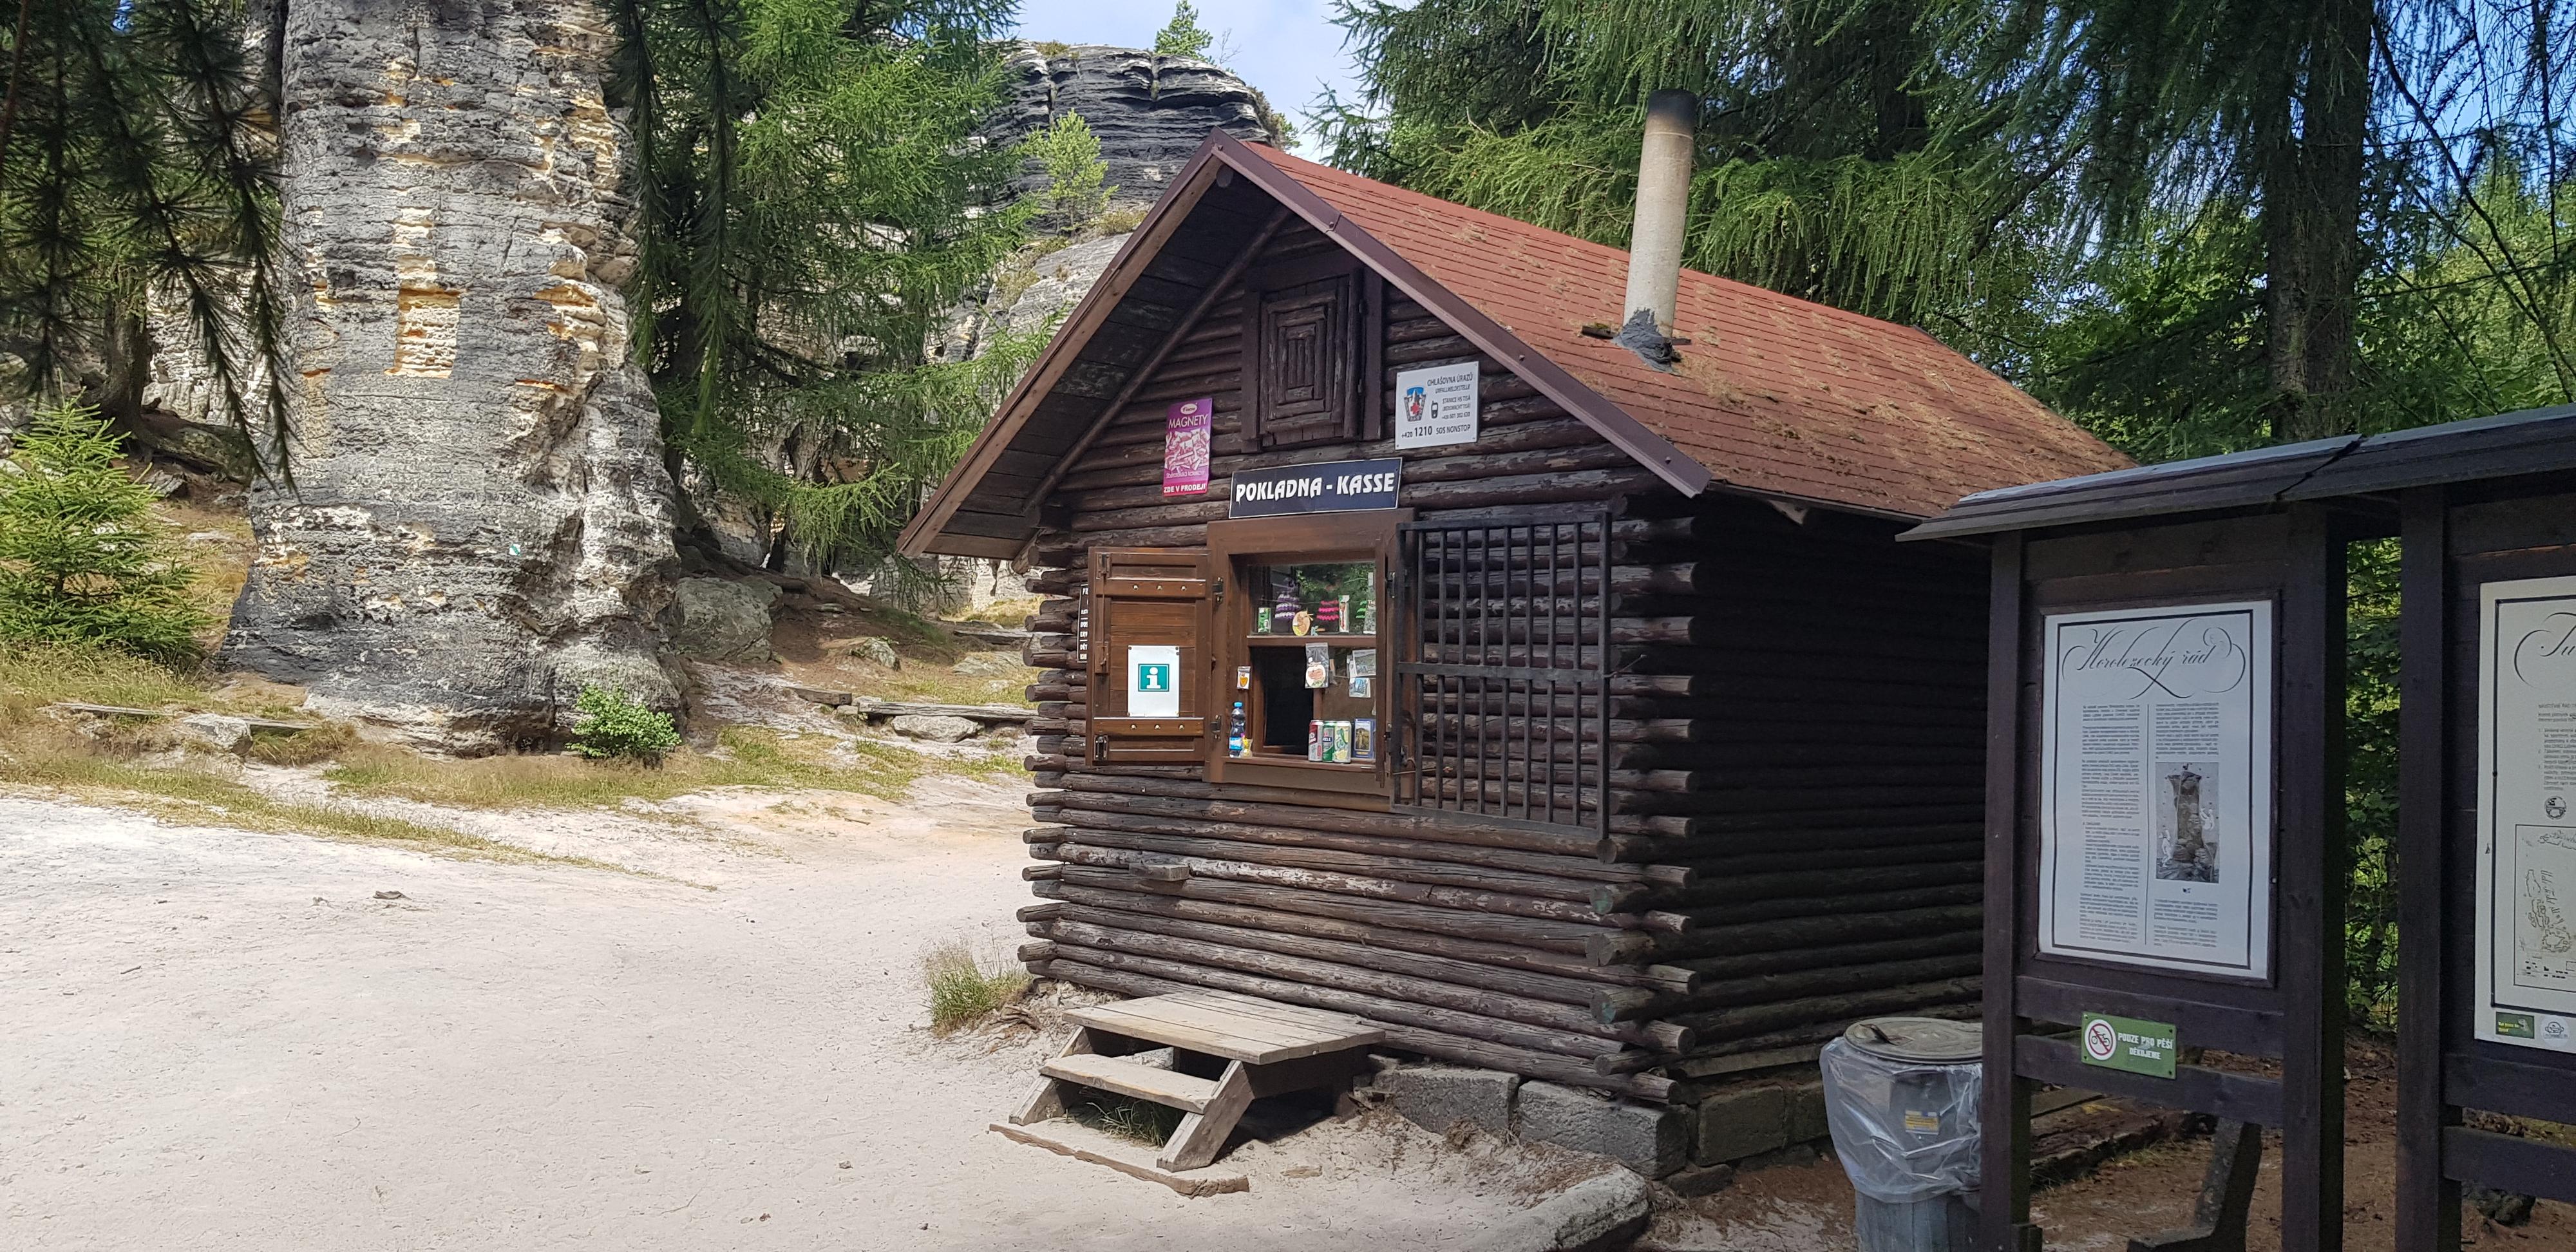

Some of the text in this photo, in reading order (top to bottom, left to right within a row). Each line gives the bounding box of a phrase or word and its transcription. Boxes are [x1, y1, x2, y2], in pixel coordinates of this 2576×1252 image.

[1168, 414, 1208, 429] MAGNETY
[1414, 426, 1432, 437] 1210
[1436, 426, 1446, 435] SOS
[1446, 424, 1471, 432] NONSTOP
[1236, 477, 1323, 502] POKLADNA
[1336, 473, 1395, 496] KASSE
[1146, 667, 1161, 689] i
[2117, 1032, 2174, 1050] POUZE PRO PĚŠÍ
